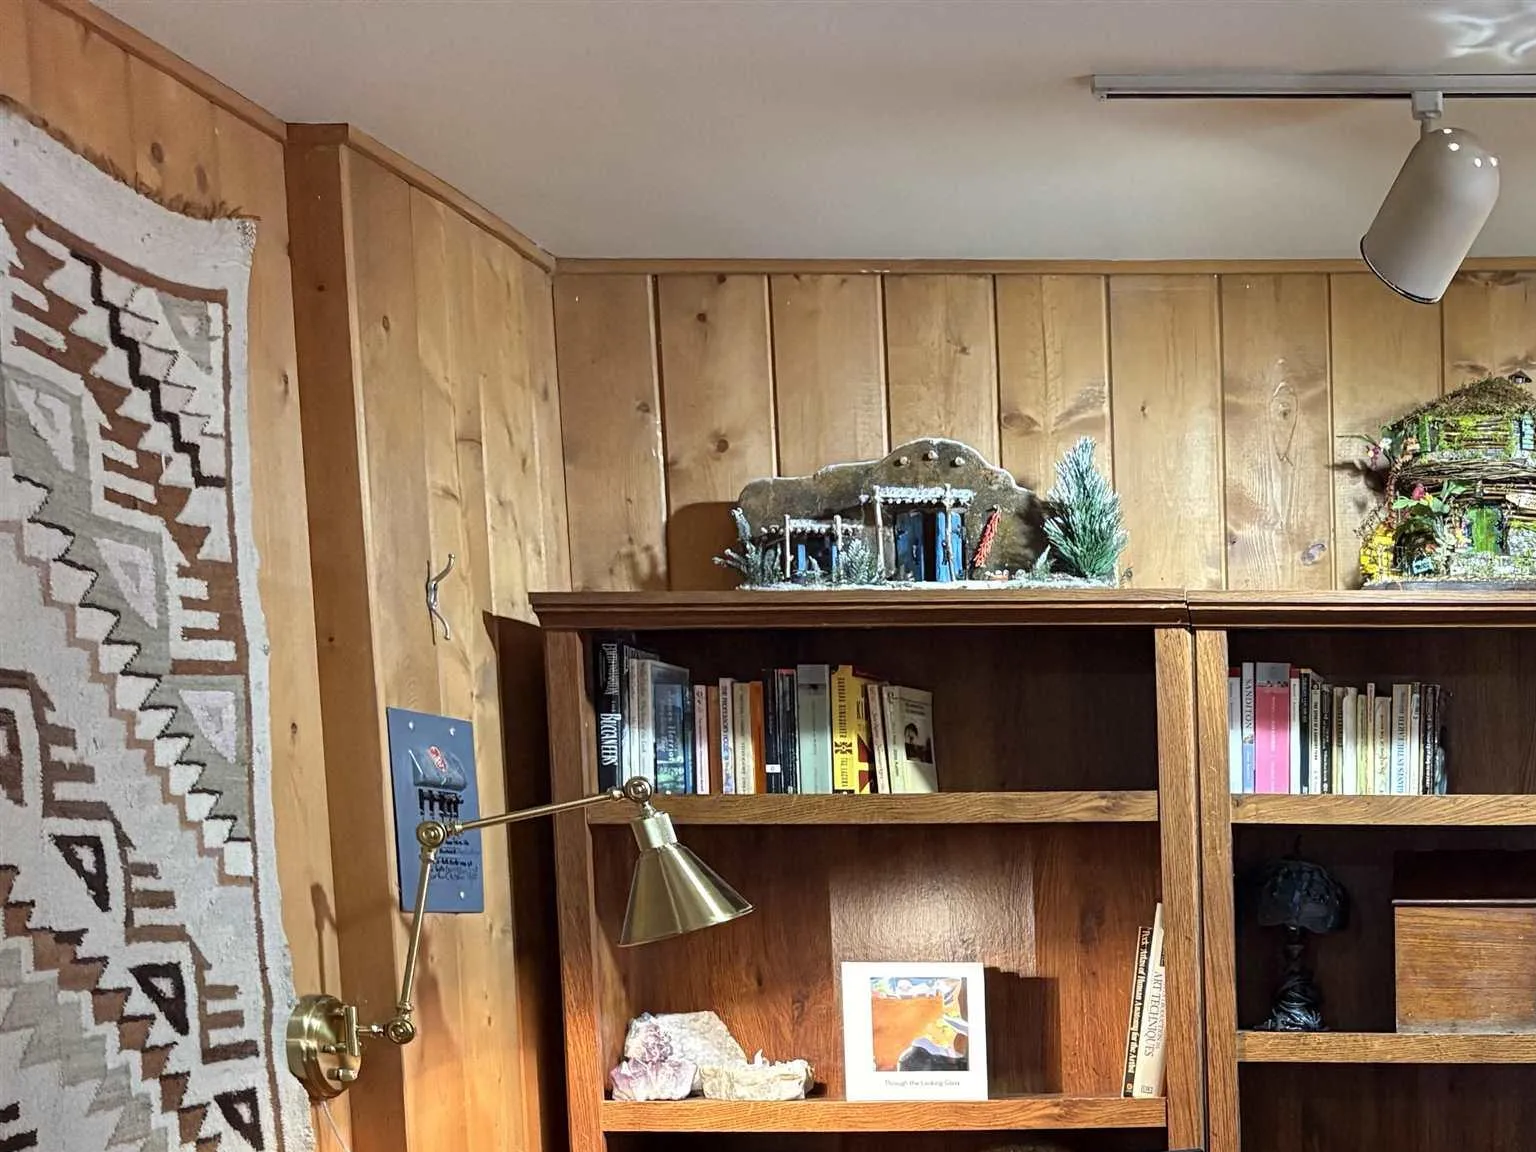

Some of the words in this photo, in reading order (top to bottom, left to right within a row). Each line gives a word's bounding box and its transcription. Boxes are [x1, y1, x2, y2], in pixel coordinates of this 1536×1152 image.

[1245, 679, 1253, 729] SANDITON
[600, 713, 622, 766] BUCCANEERS
[1135, 975, 1146, 1000] Human
[1153, 971, 1163, 991] ART
[1144, 994, 1162, 1057] TECHNIQUES
